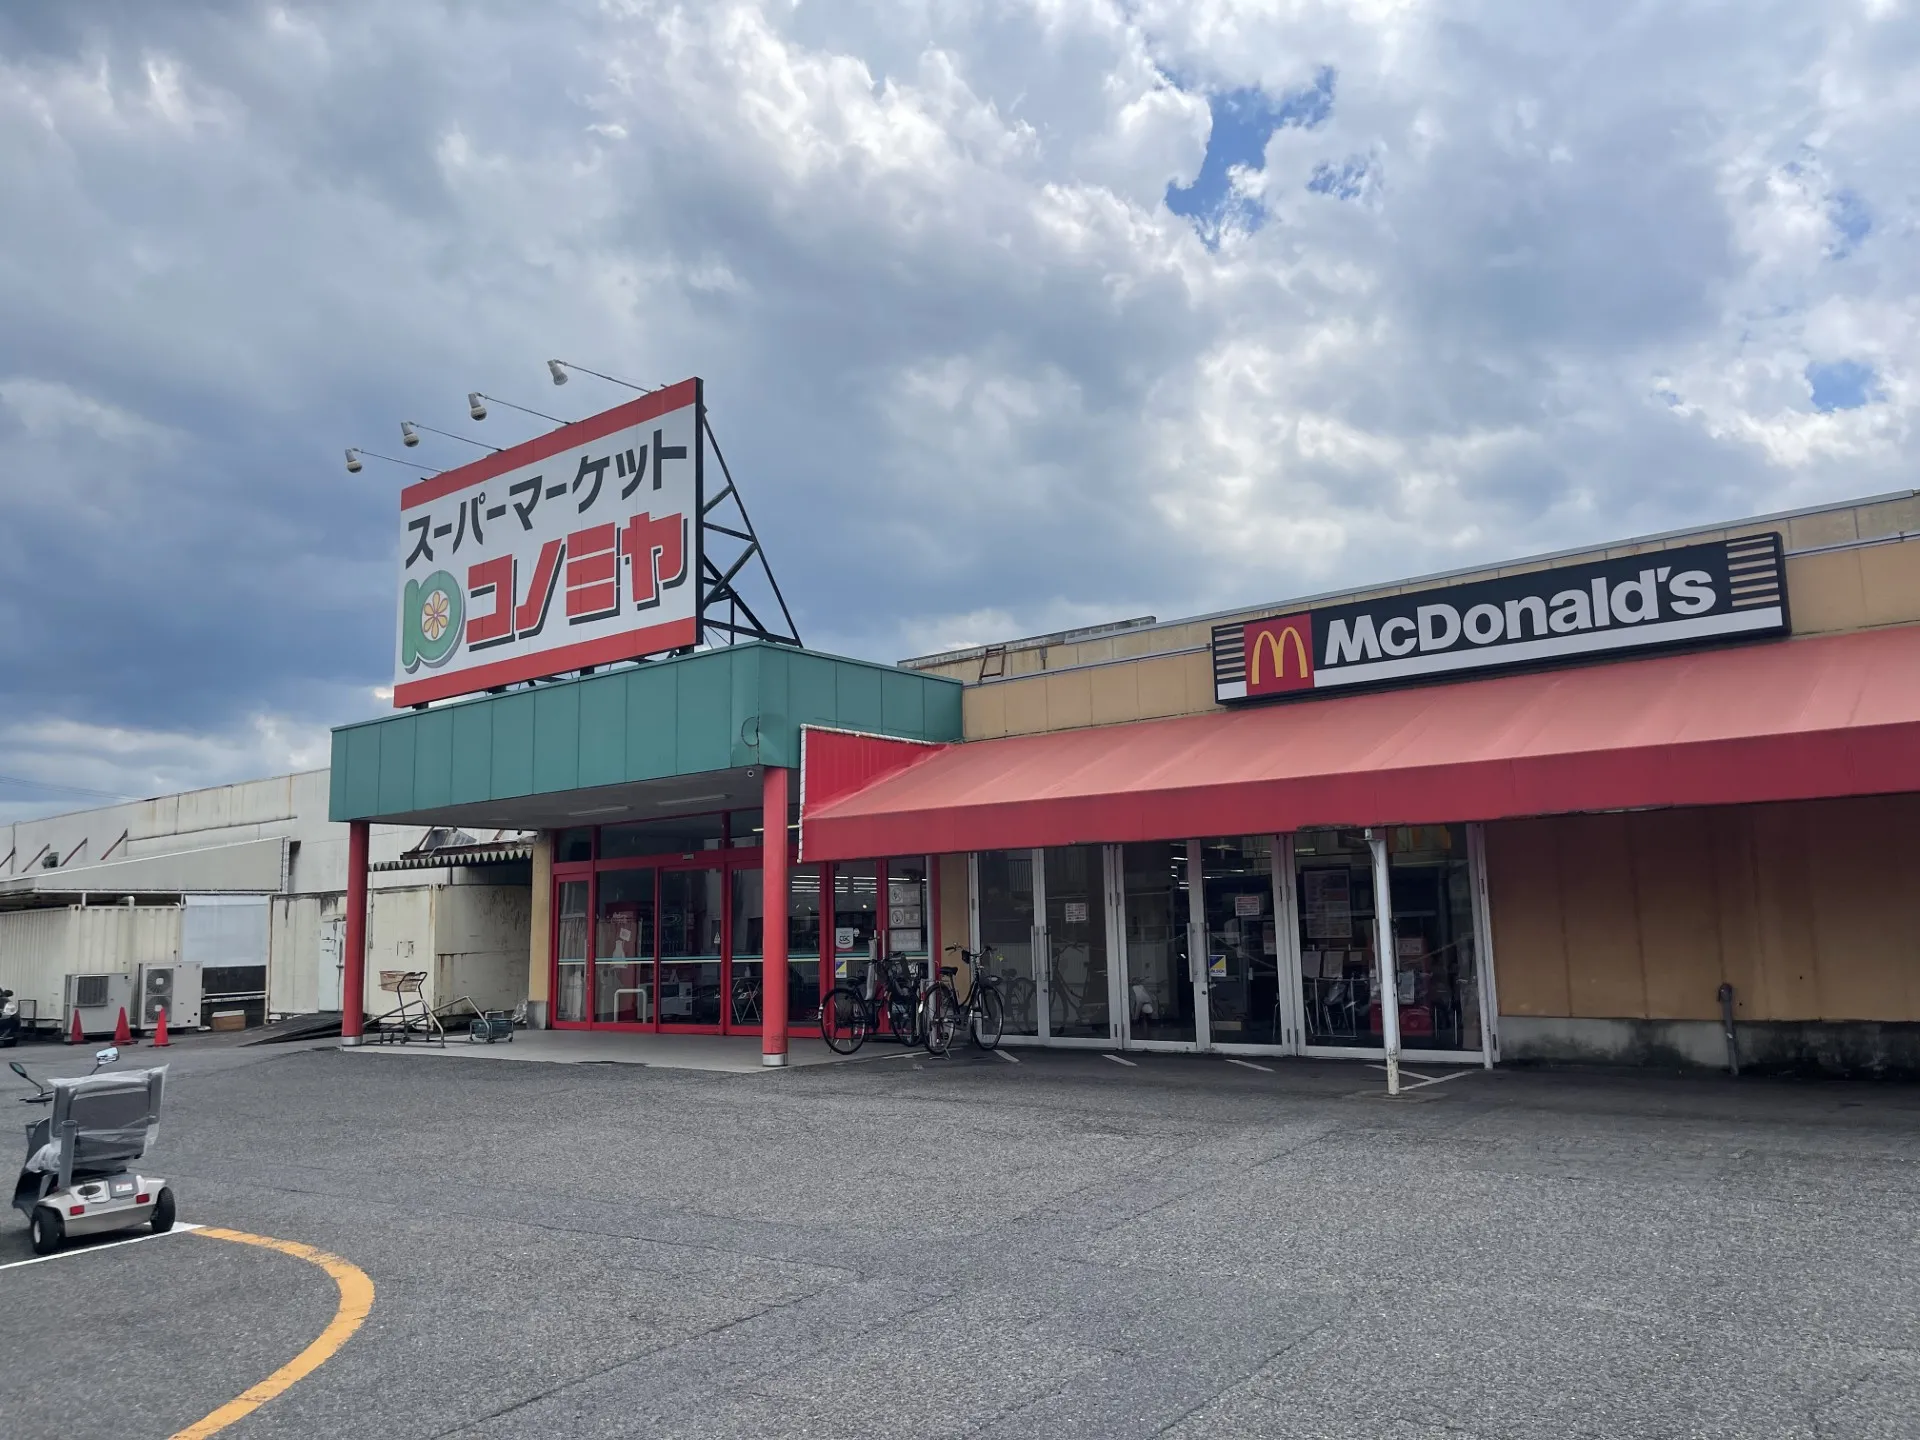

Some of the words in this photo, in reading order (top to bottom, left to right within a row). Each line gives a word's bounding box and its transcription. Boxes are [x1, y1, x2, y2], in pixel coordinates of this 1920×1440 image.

[405, 429, 687, 569] スーパーマーケット
[466, 511, 688, 652] コノミヤ
[1325, 566, 1717, 665] McDonald's
